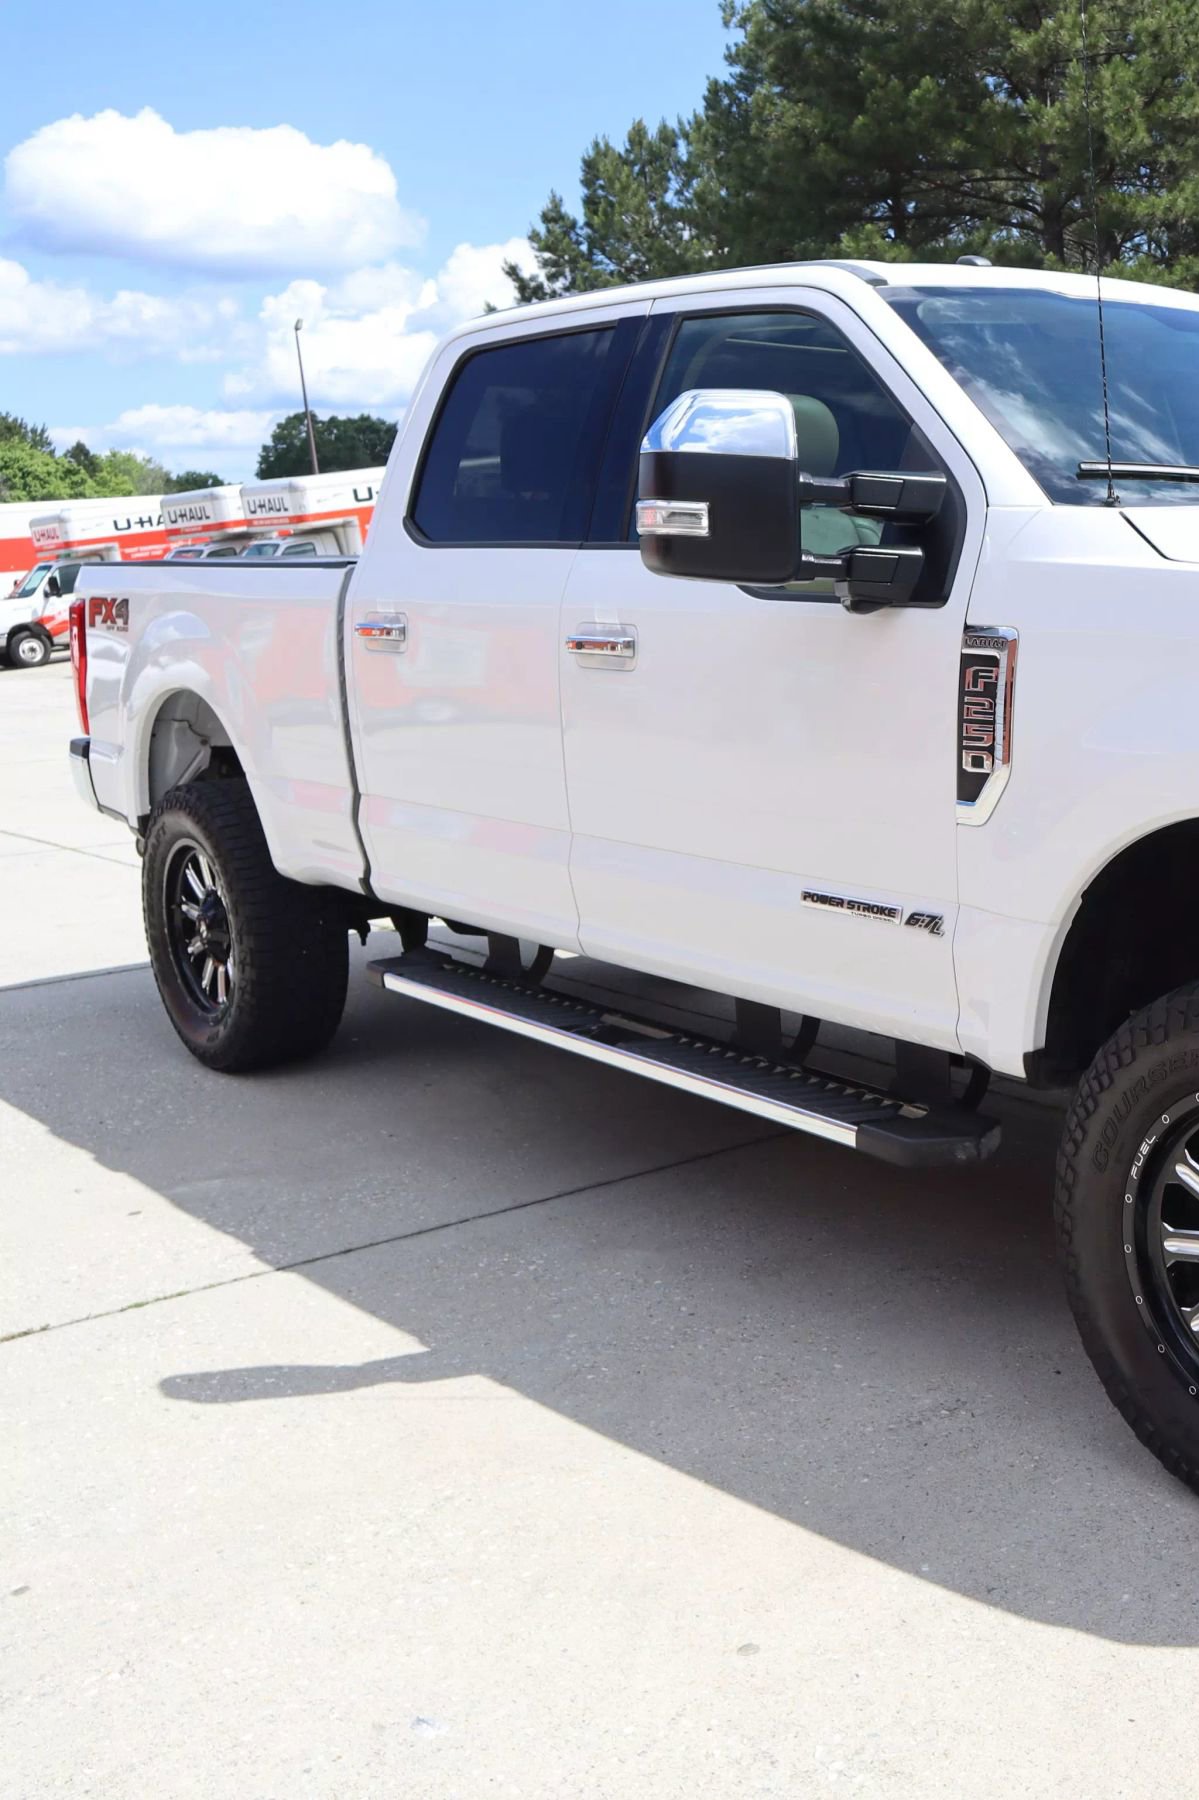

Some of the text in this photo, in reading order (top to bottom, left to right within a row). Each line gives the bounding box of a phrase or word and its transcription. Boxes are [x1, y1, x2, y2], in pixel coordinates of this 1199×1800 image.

[168, 506, 211, 524] U-HAUL
[247, 497, 289, 514] U-HAUL
[89, 597, 129, 628] FX4
[964, 636, 1008, 650] LARIAT
[803, 890, 845, 909] POWER
[847, 899, 898, 919] STROKE
[1130, 1135, 1157, 1180] FUEL
